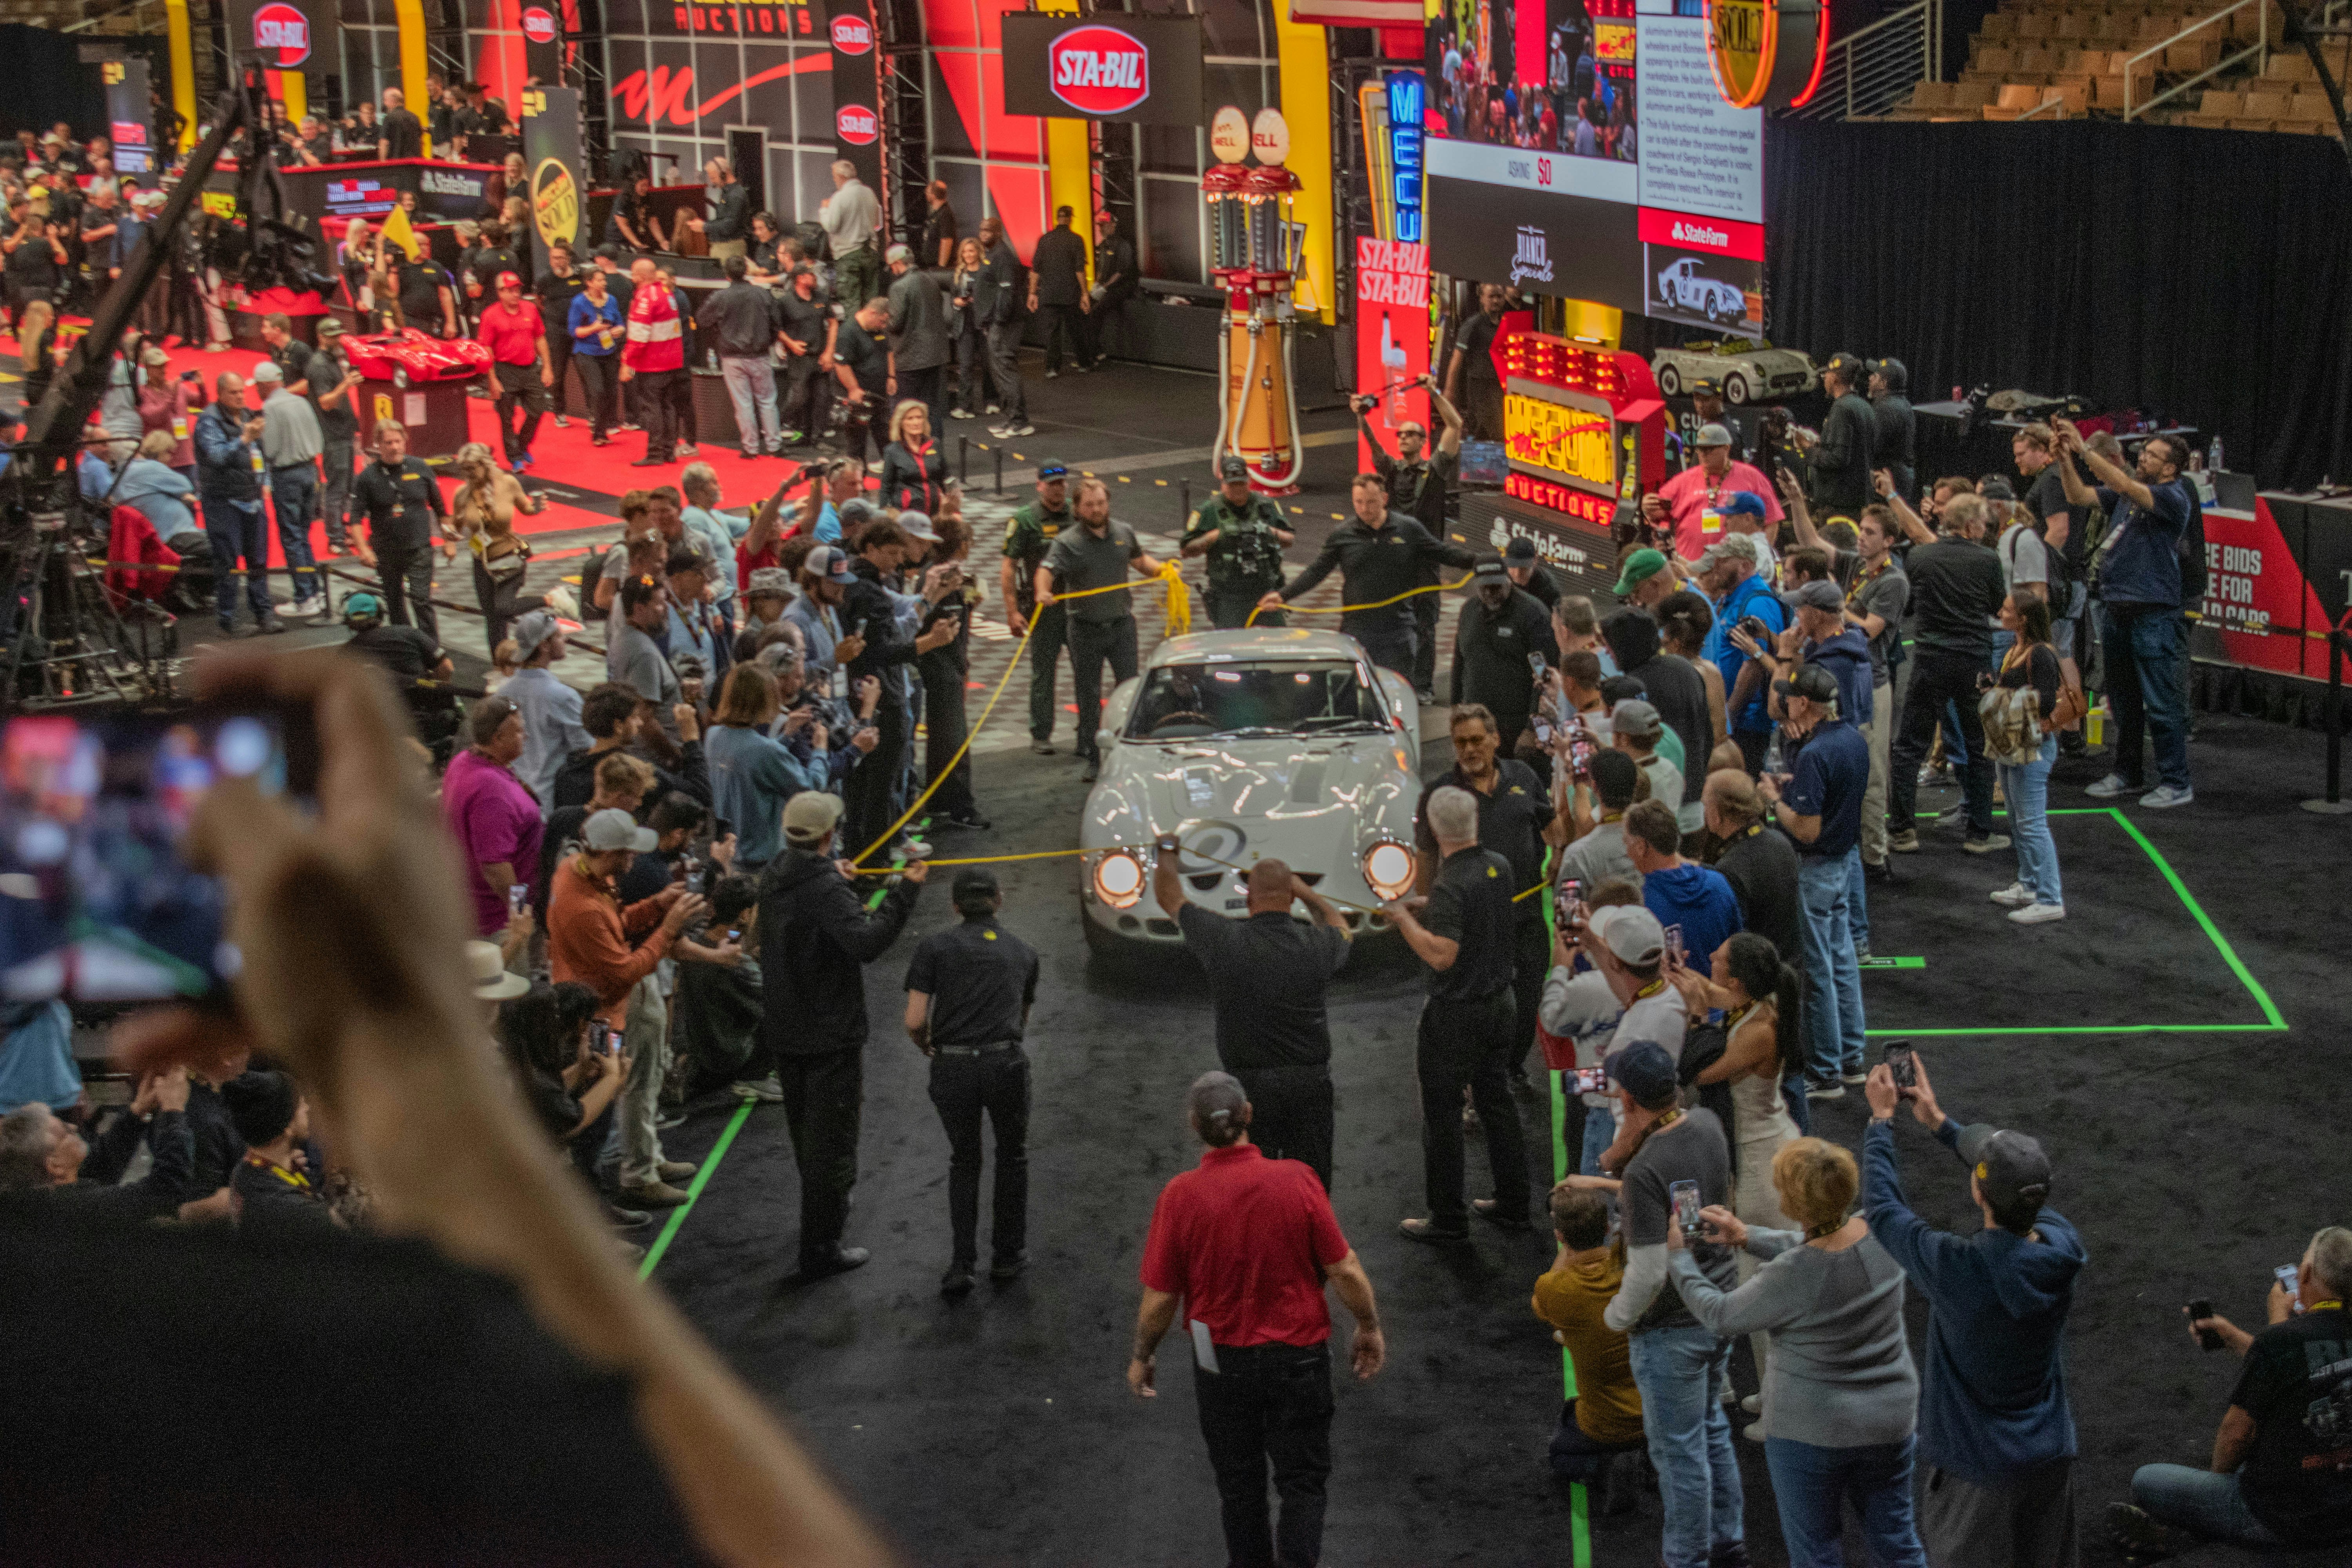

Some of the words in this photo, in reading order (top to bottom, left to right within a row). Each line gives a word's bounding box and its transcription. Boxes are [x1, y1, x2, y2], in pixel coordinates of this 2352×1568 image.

[674, 7, 813, 34] AUCTIONS
[1057, 50, 1142, 89] STA-BIL
[1391, 82, 1415, 241] MECU
[1538, 156, 1552, 187] $0
[1359, 238, 1429, 275] STA-BIL
[1359, 271, 1429, 308] STA-BIL
[1504, 473, 1617, 526] AUCTIONS
[2223, 545, 2262, 575] BIDS
[2221, 574, 2252, 604] FOR
